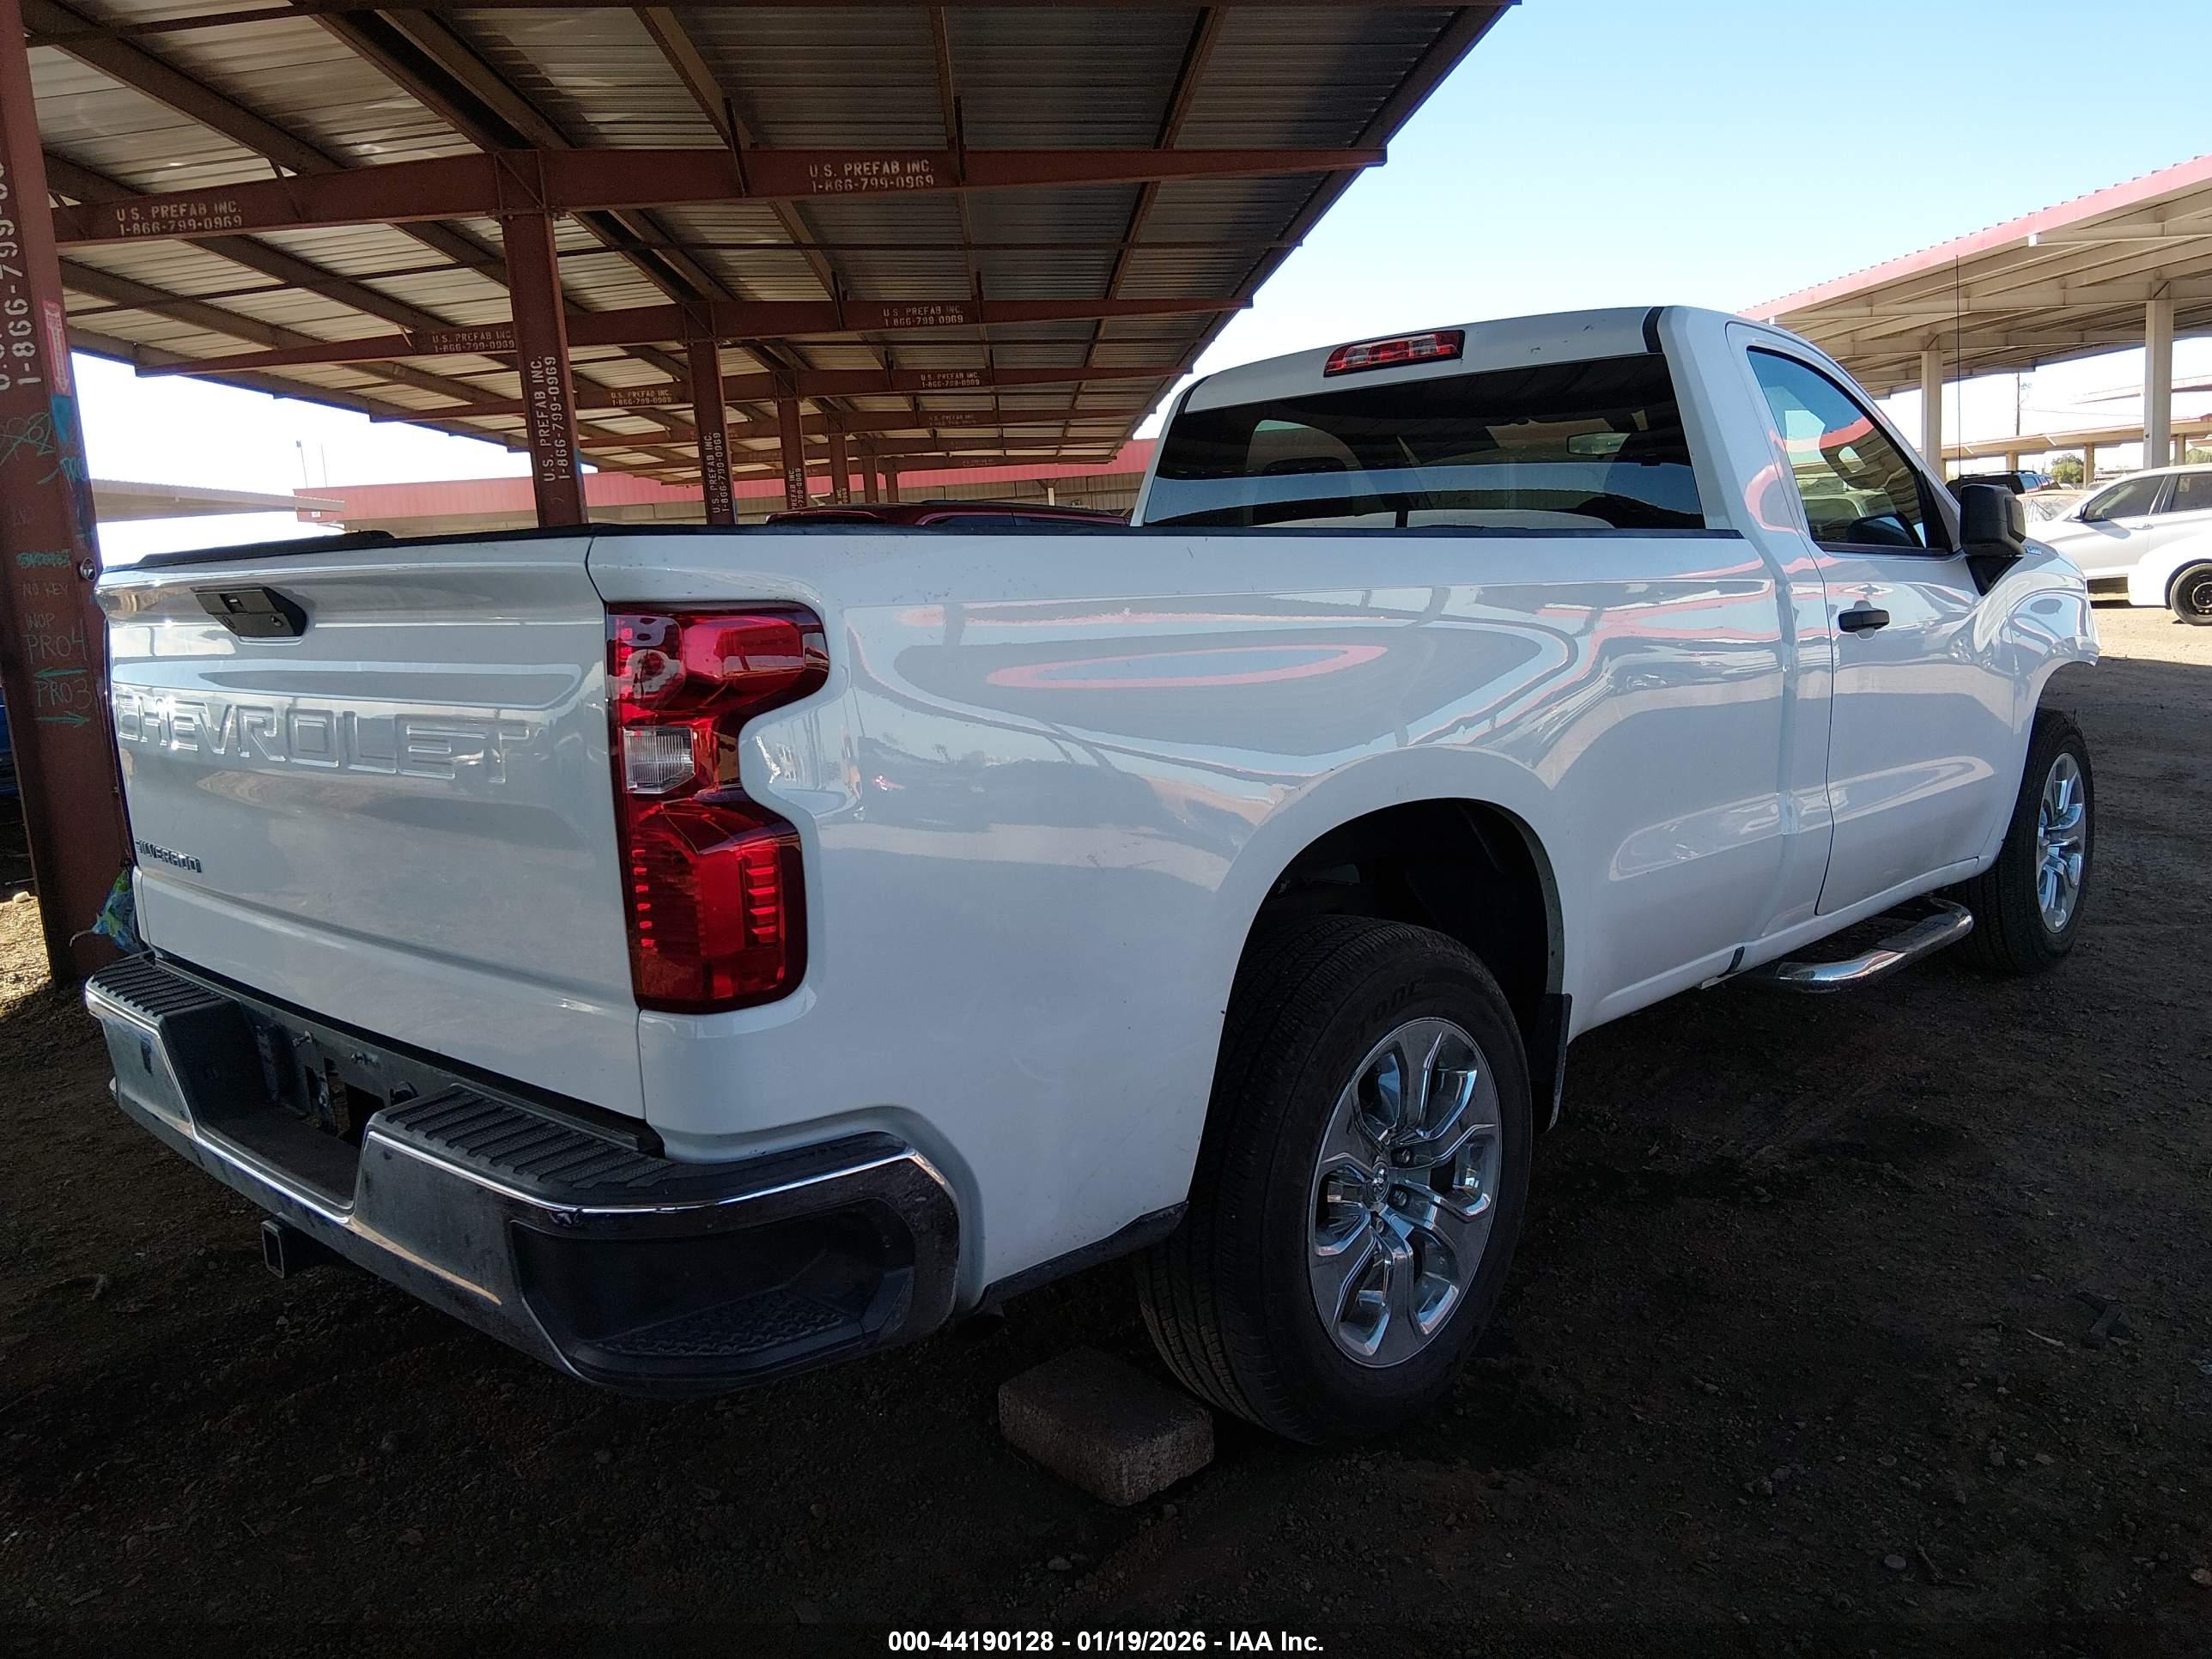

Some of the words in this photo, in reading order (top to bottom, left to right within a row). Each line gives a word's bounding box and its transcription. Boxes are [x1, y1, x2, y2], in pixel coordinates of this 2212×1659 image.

[843, 160, 900, 176] PREFAB
[907, 158, 934, 173] INC.
[811, 174, 934, 193] 1-866-799-0969
[151, 203, 207, 218] PREFAB
[215, 200, 241, 214] INC.
[119, 215, 242, 235] 1-866-799-0969
[906, 306, 942, 316] PREFAB
[455, 331, 492, 342] PREFAB
[530, 356, 544, 383] INC.
[533, 391, 552, 447] PREFAB
[544, 356, 571, 480] 1-866-799-0969
[704, 432, 714, 451] INC.
[542, 453, 556, 482] U.S.
[706, 454, 718, 491] PREFAB
[789, 484, 798, 509] REFAB
[112, 692, 530, 783] CHEVROLET
